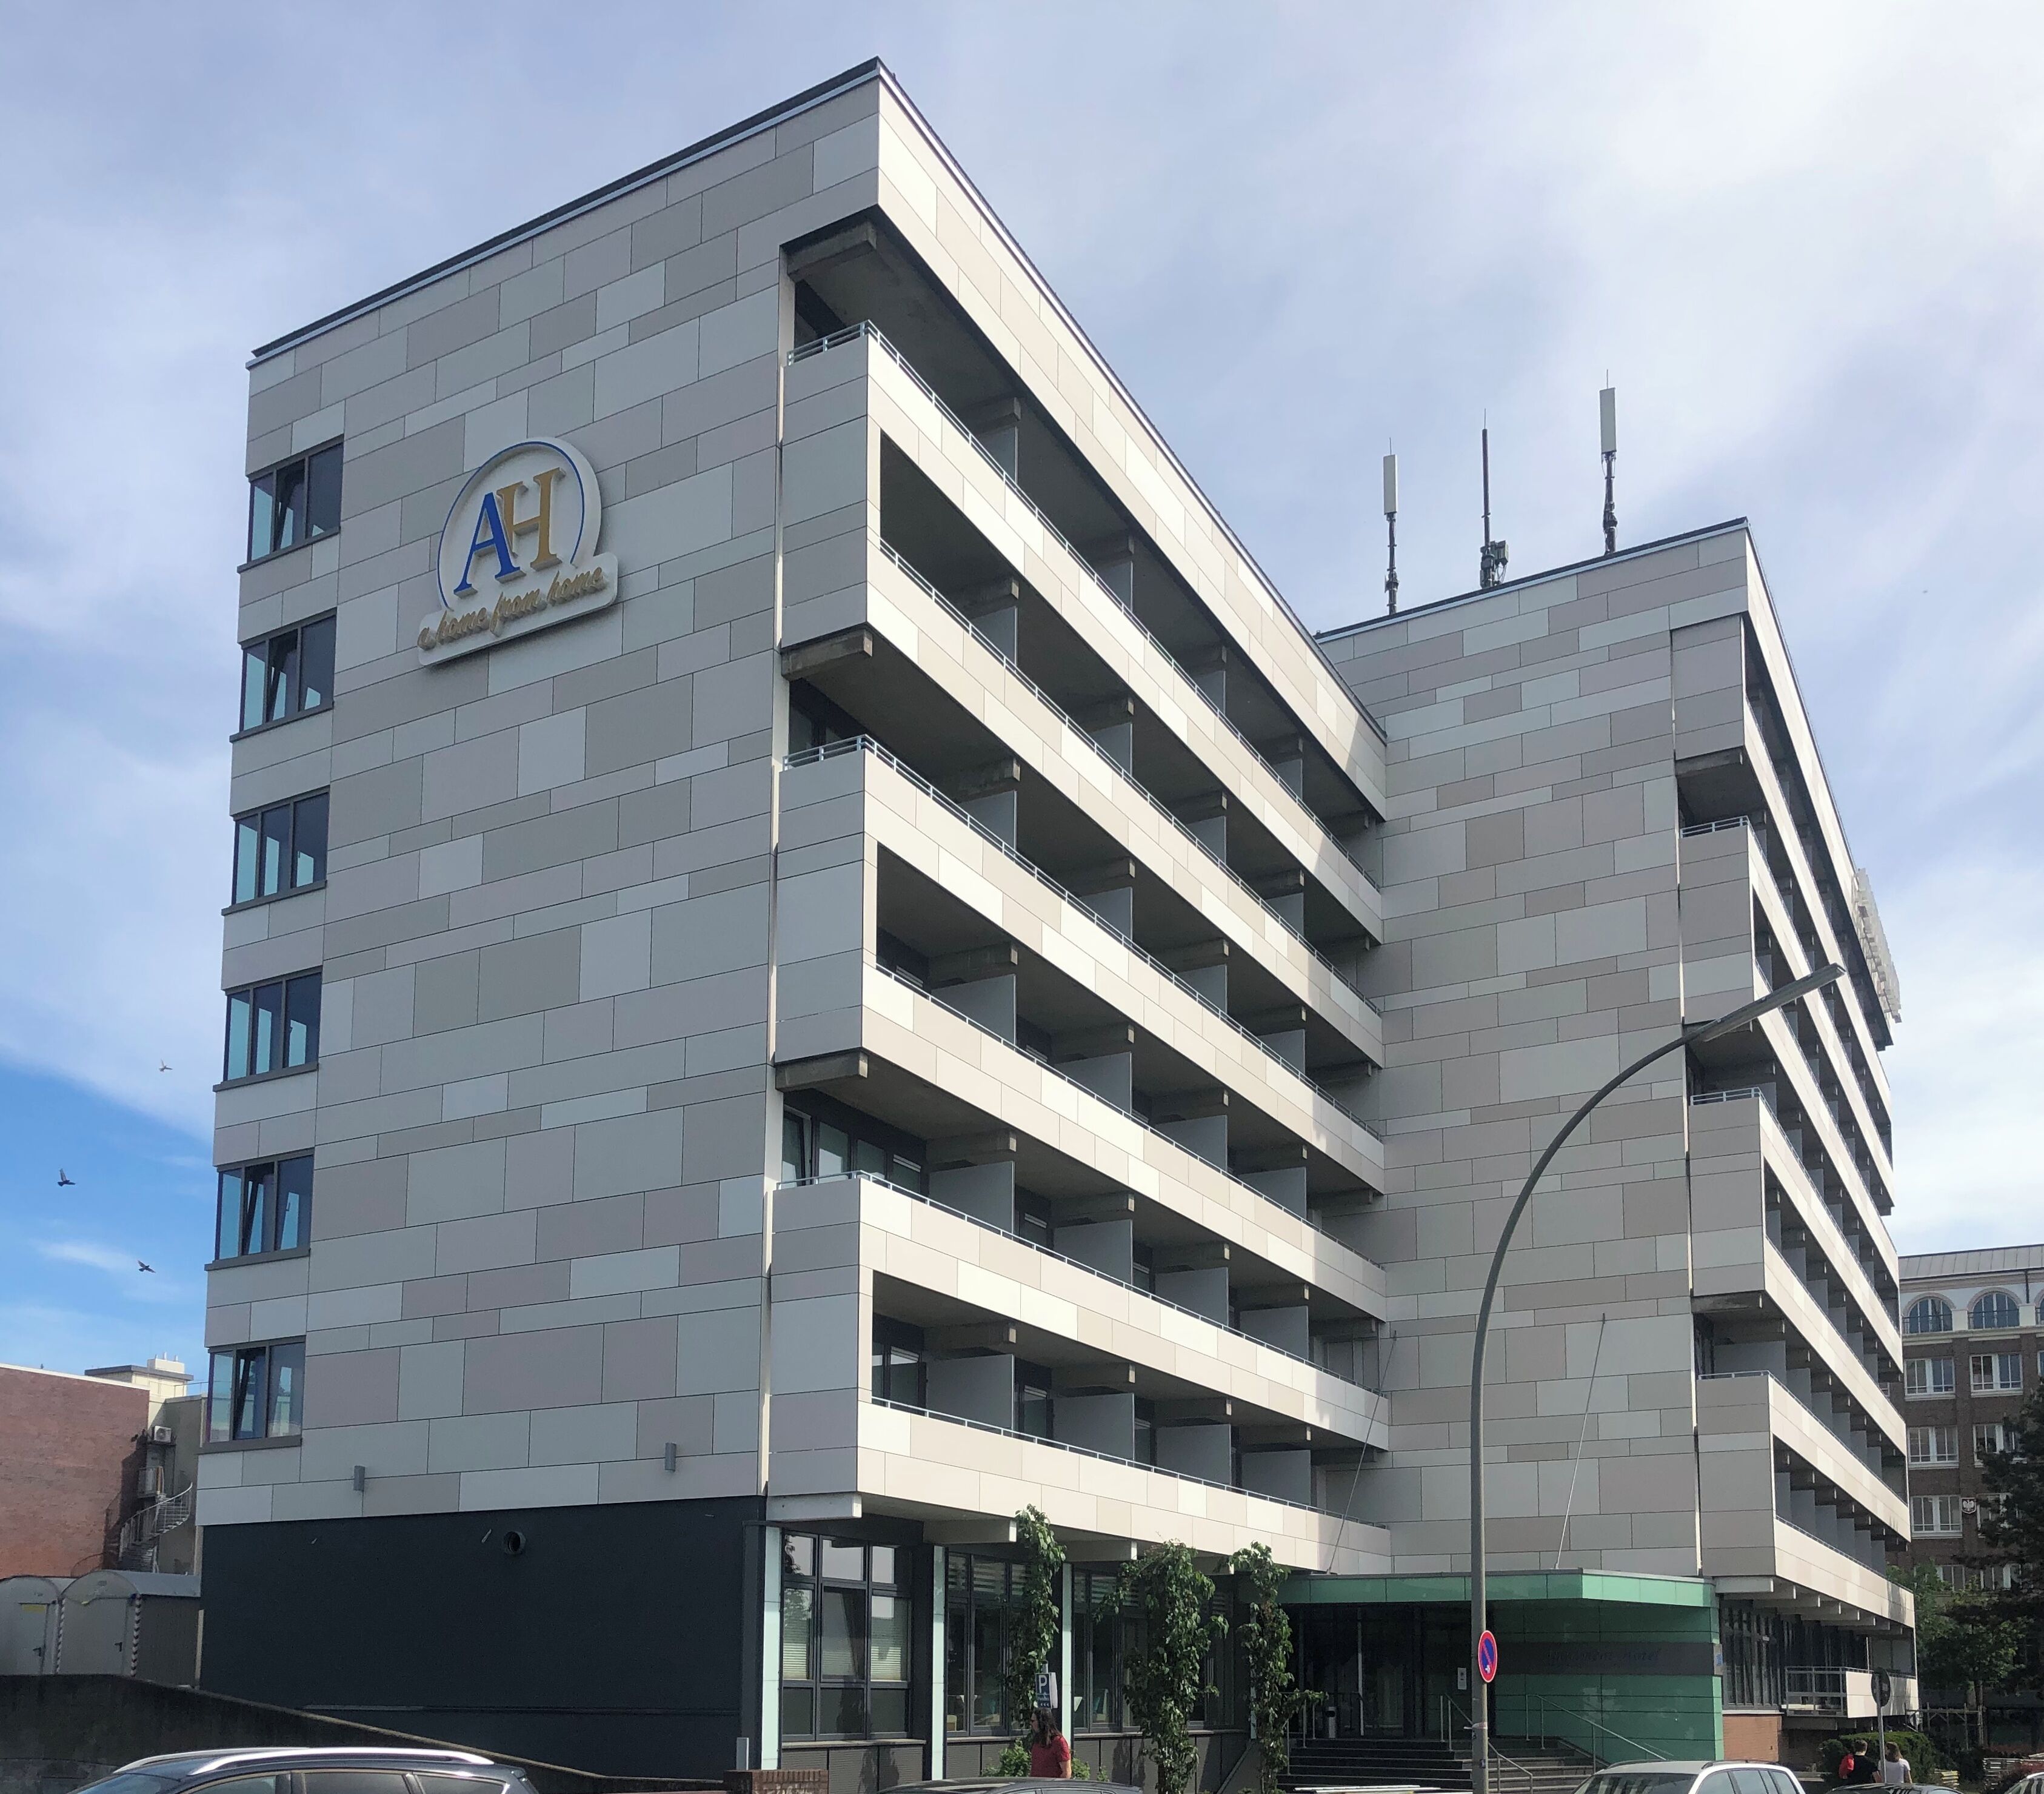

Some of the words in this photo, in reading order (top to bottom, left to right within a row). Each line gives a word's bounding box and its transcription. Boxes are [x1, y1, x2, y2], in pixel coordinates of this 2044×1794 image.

[453, 467, 564, 597] AH
[436, 607, 489, 644] home
[489, 588, 544, 636] from
[547, 566, 605, 606] home
[1038, 1675, 1047, 1693] P
